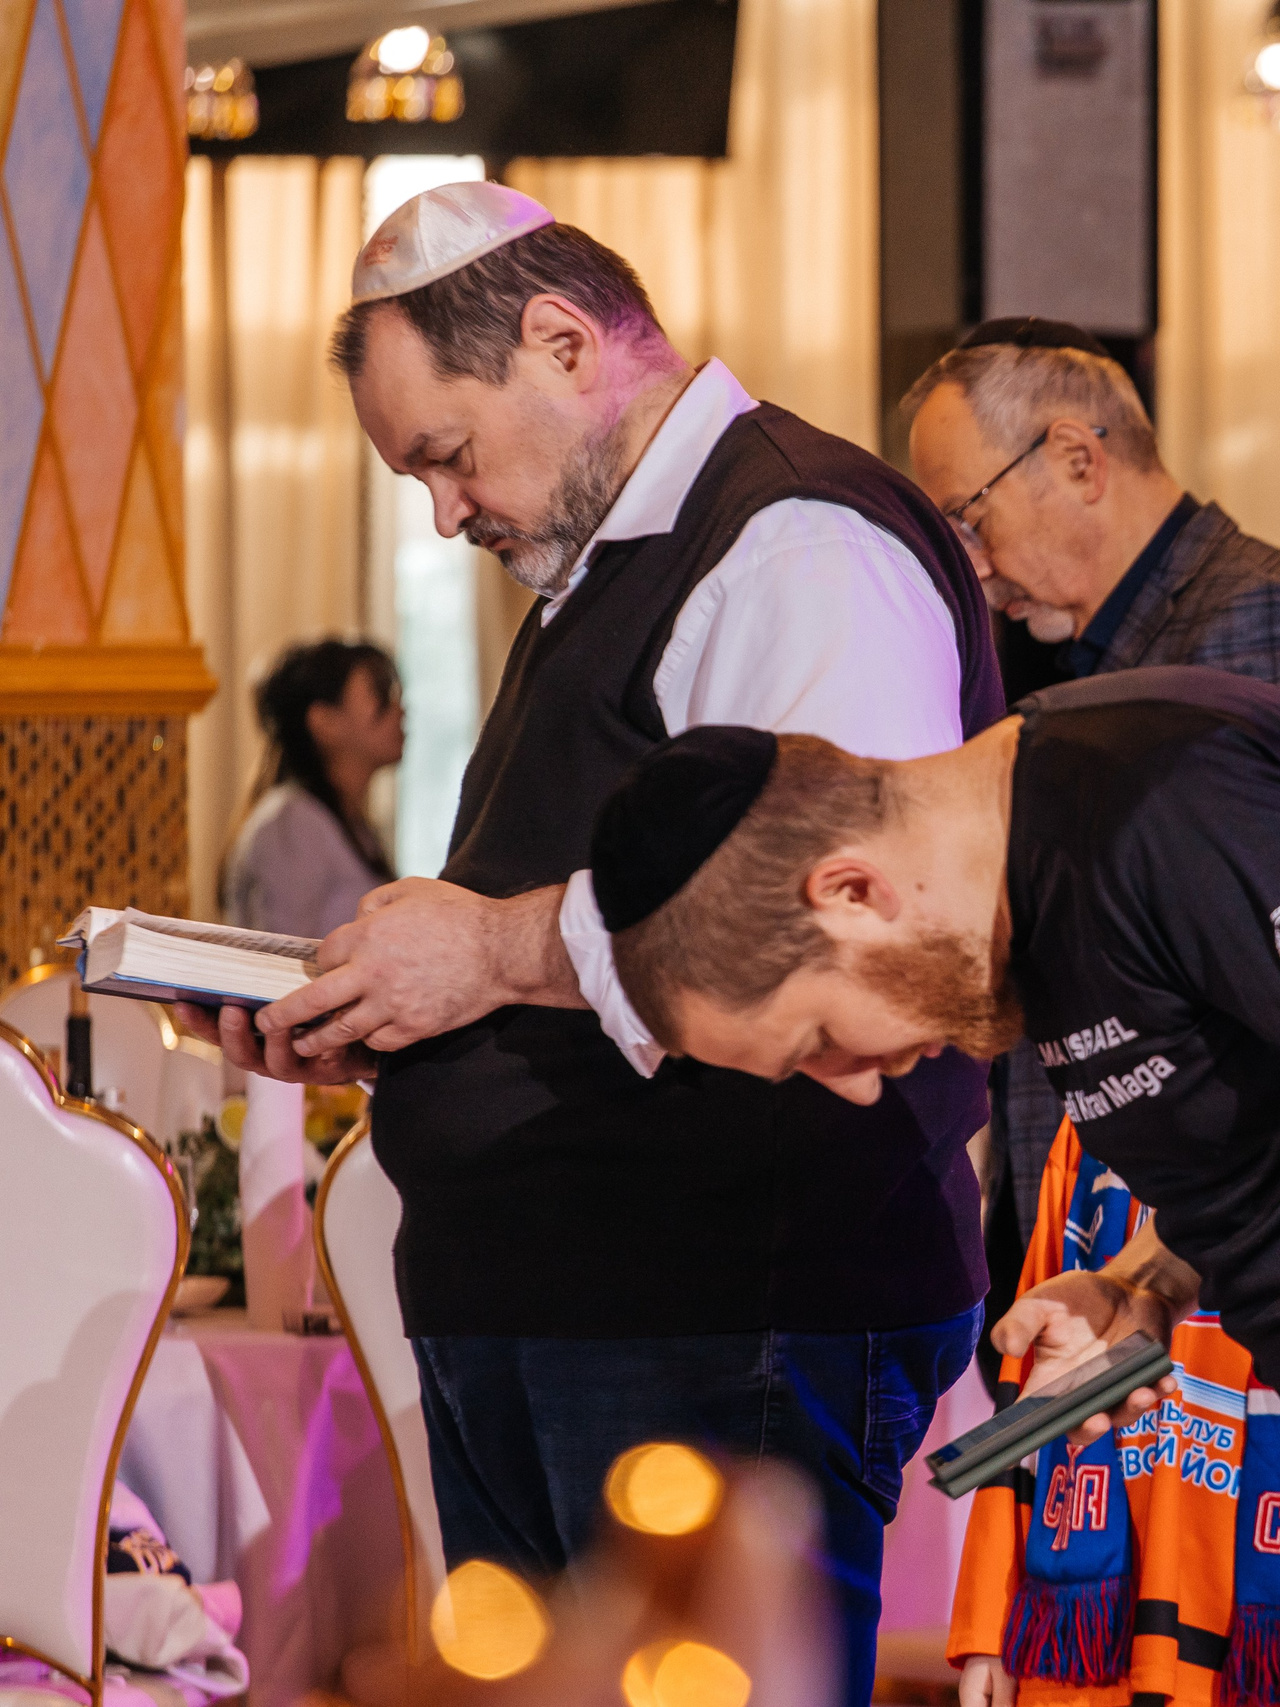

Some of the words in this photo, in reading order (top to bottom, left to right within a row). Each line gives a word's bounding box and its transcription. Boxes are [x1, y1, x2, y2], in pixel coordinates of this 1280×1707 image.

[1062, 1016, 1139, 1062] ISRAEL
[1074, 1089, 1114, 1121] Krav
[1099, 1055, 1177, 1109] Maga
